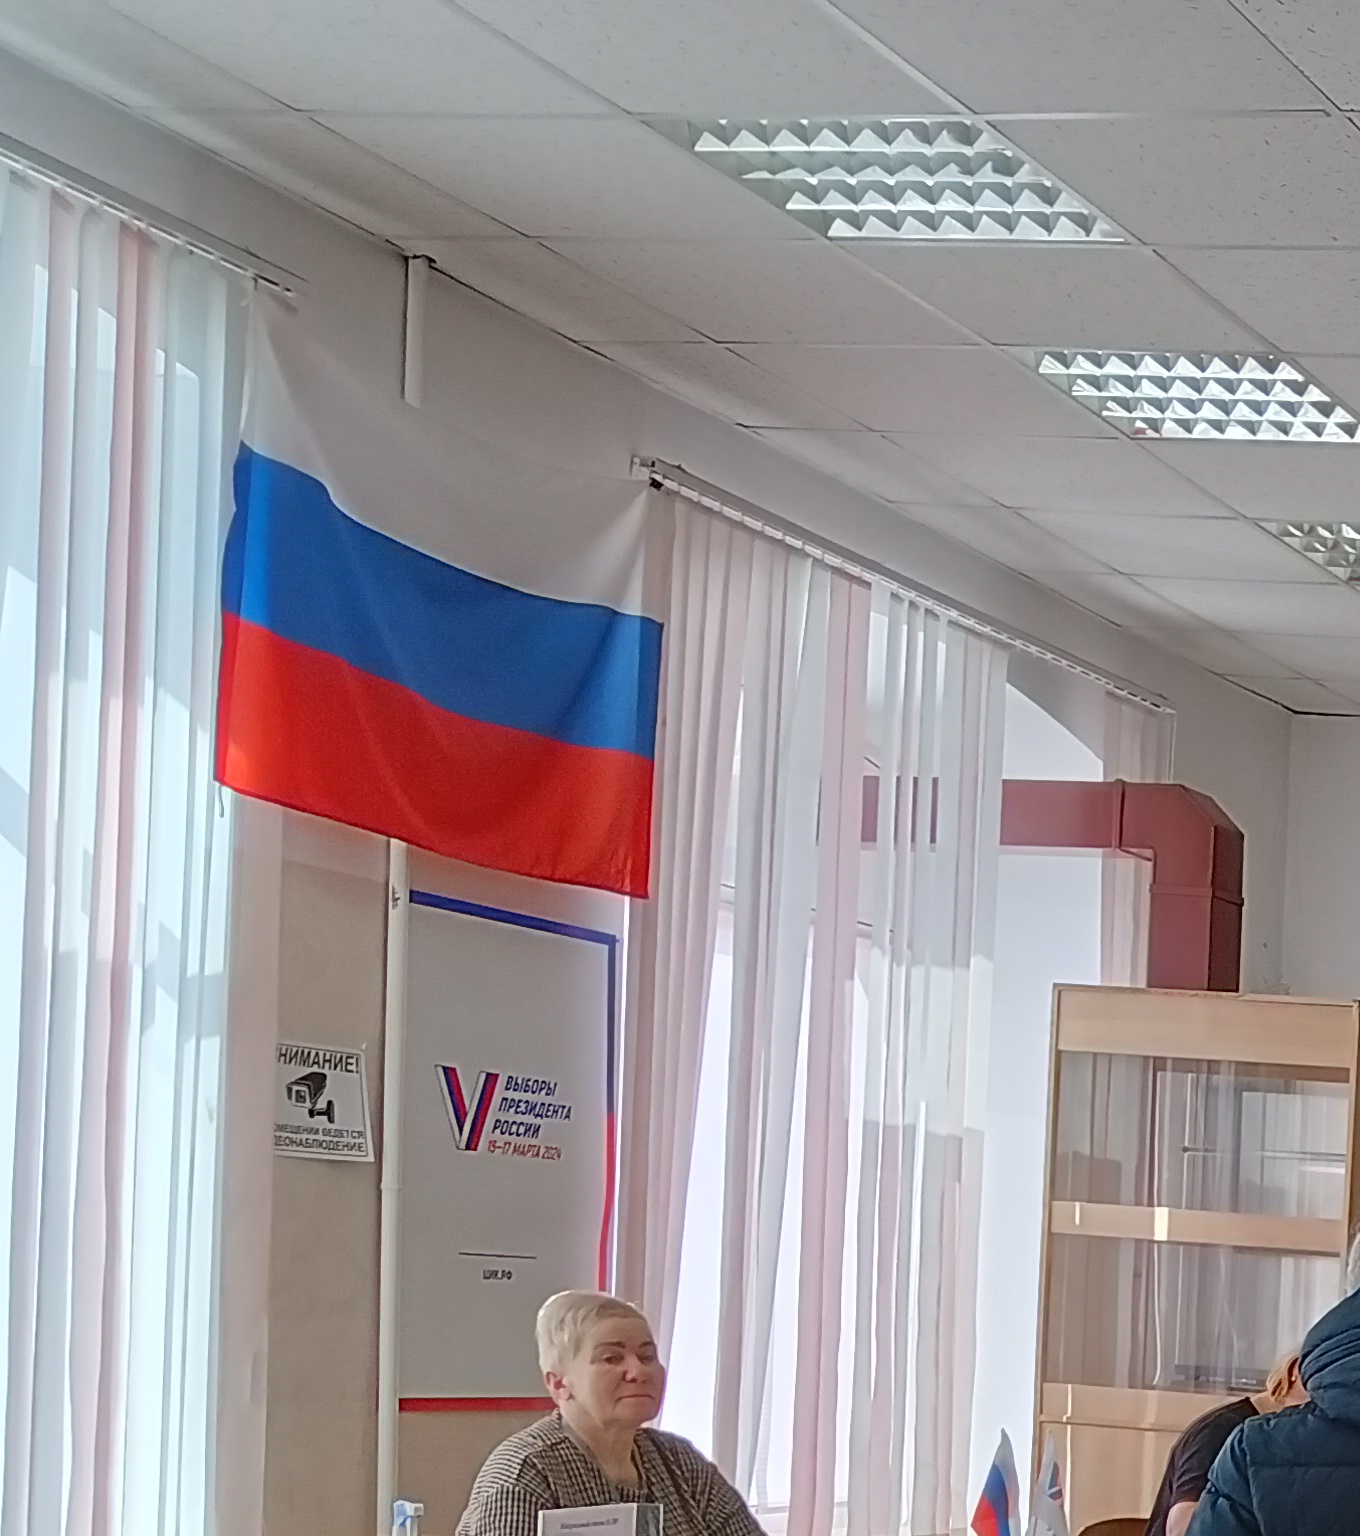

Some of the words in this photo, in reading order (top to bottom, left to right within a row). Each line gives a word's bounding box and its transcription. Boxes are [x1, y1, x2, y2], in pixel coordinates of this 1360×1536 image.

[276, 1046, 360, 1074] НИМАНИЕ!
[504, 1075, 557, 1097] ВЫБОРЫ
[498, 1097, 572, 1121] ПРЕЗИДЕНТА
[491, 1119, 541, 1139] РОССИИ
